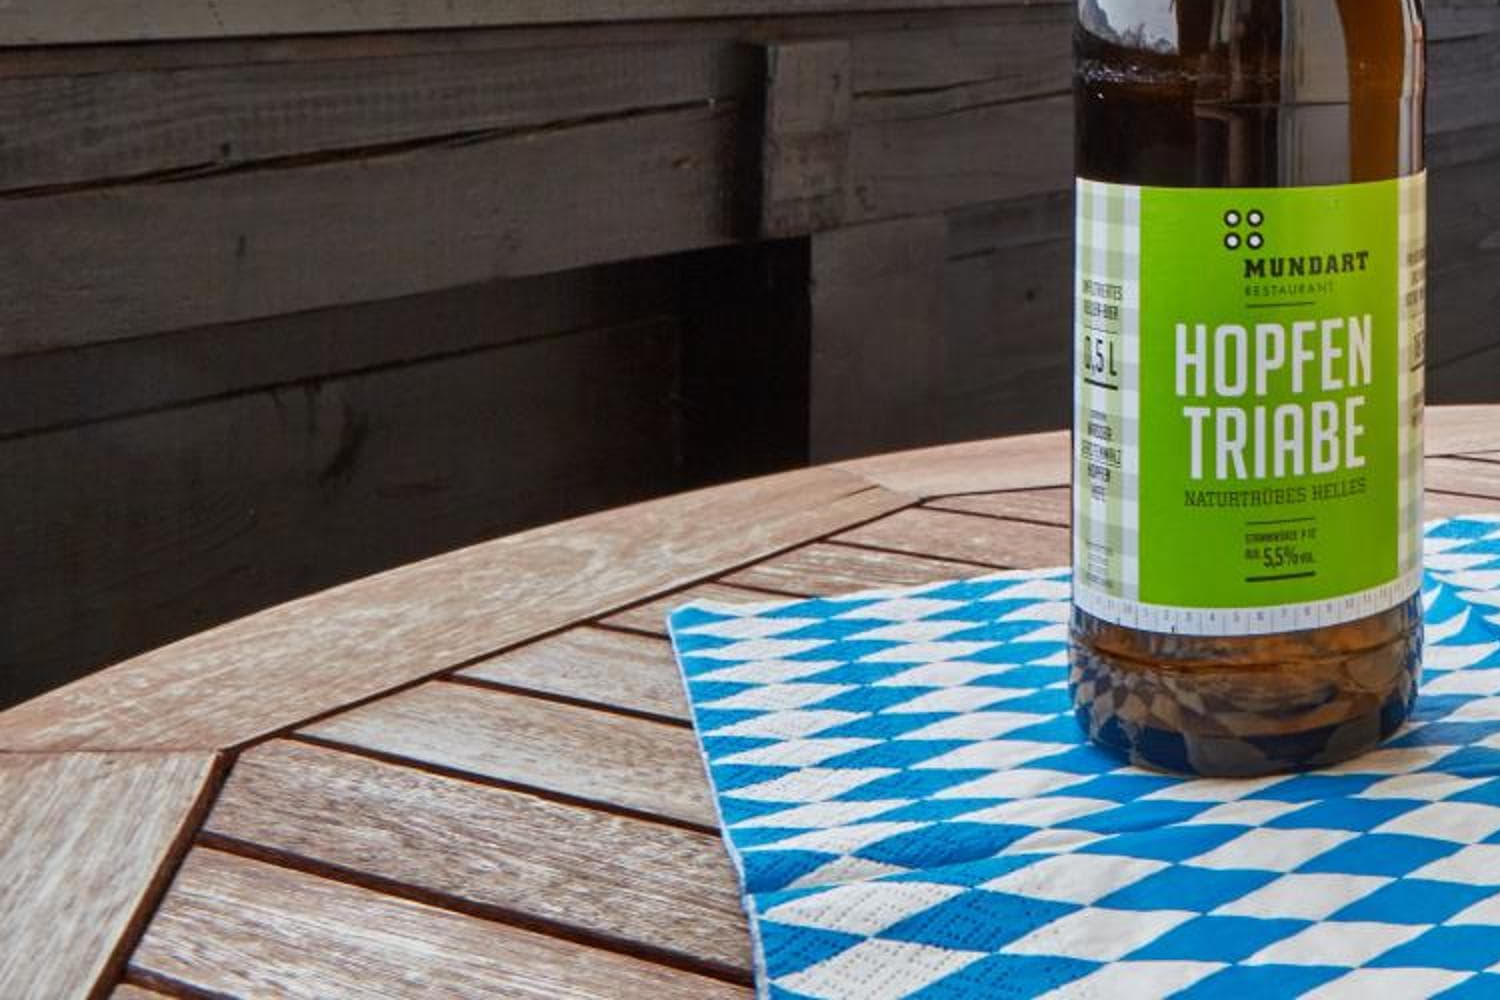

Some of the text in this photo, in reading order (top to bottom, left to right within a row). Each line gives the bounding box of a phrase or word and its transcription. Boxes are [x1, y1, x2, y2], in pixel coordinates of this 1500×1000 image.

[1244, 251, 1369, 279] MUNDART
[1245, 282, 1334, 297] RESTAURANT
[1175, 313, 1373, 398] HOPFEN
[1183, 395, 1367, 481] TRIABE
[1184, 478, 1368, 508] NATURTRÜBES HELLES
